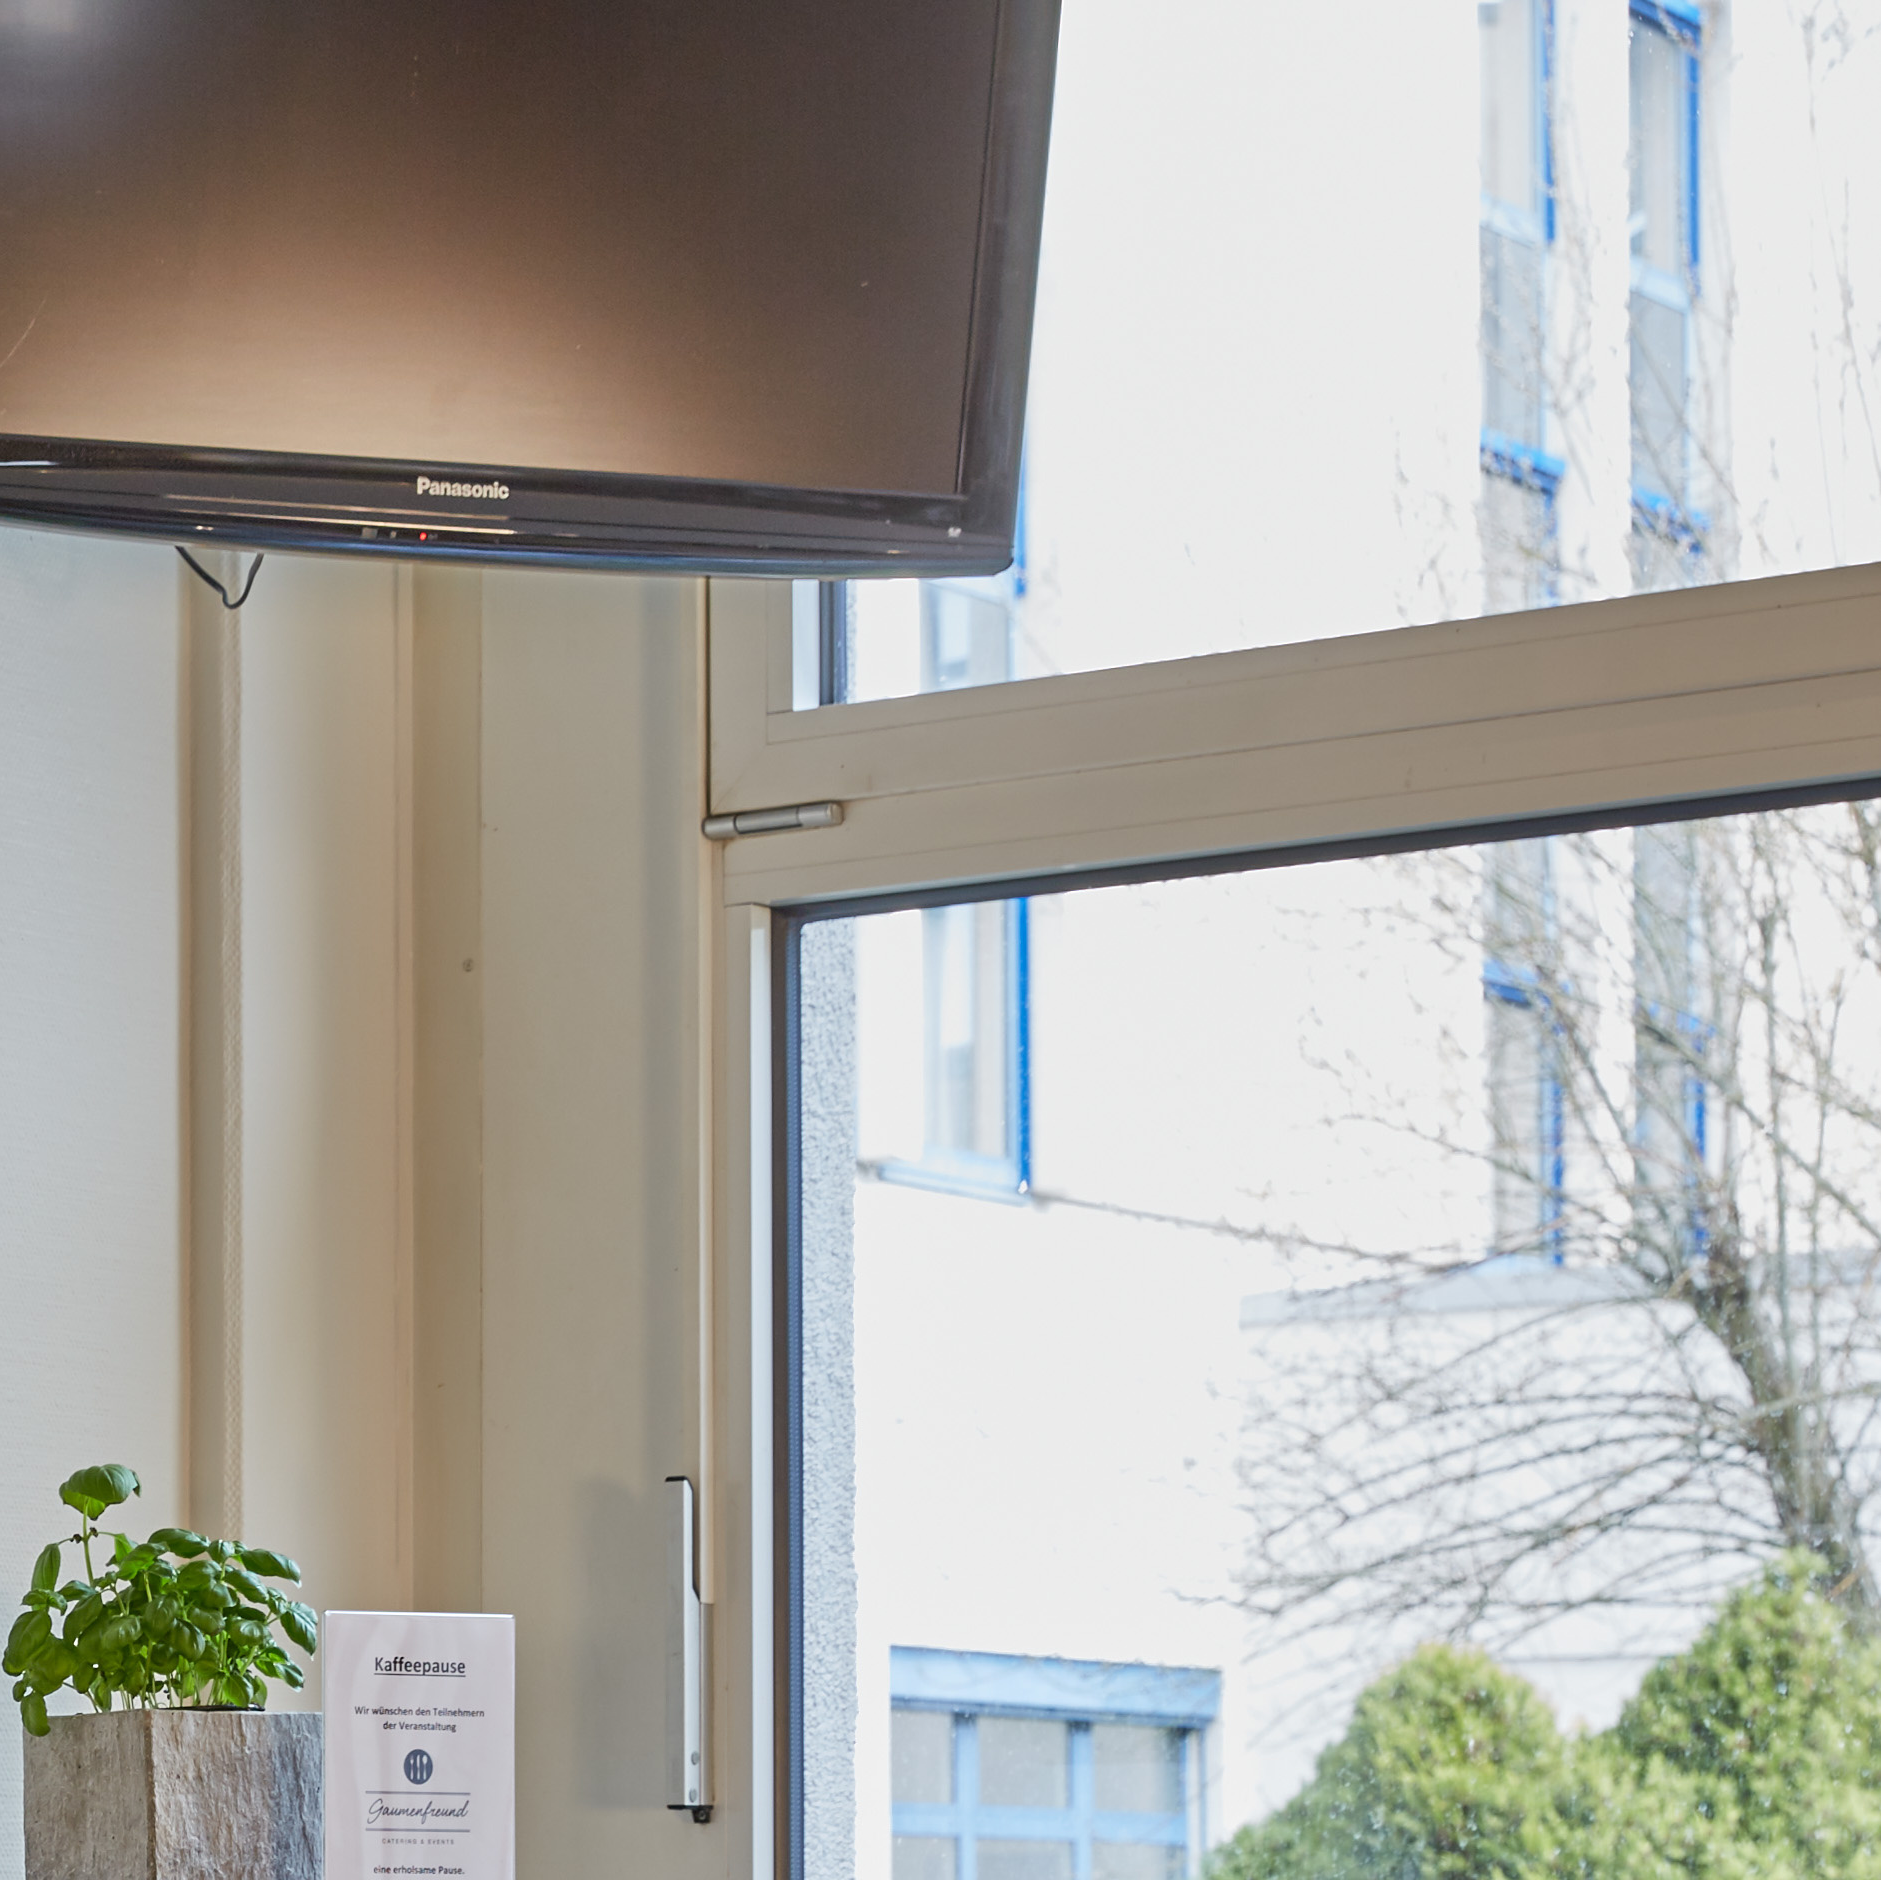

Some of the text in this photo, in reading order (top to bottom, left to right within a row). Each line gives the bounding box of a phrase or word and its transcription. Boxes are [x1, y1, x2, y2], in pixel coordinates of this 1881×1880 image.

[416, 475, 510, 500] Panasonic
[374, 1656, 466, 1676] Kaffeepause
[354, 1706, 485, 1718] Wir wünschen den Teilnehmern
[382, 1721, 457, 1733] der Veranstaltung
[367, 1798, 469, 1825] Gaumenfreund
[373, 1865, 391, 1874] eine
[393, 1865, 436, 1875] erholsame
